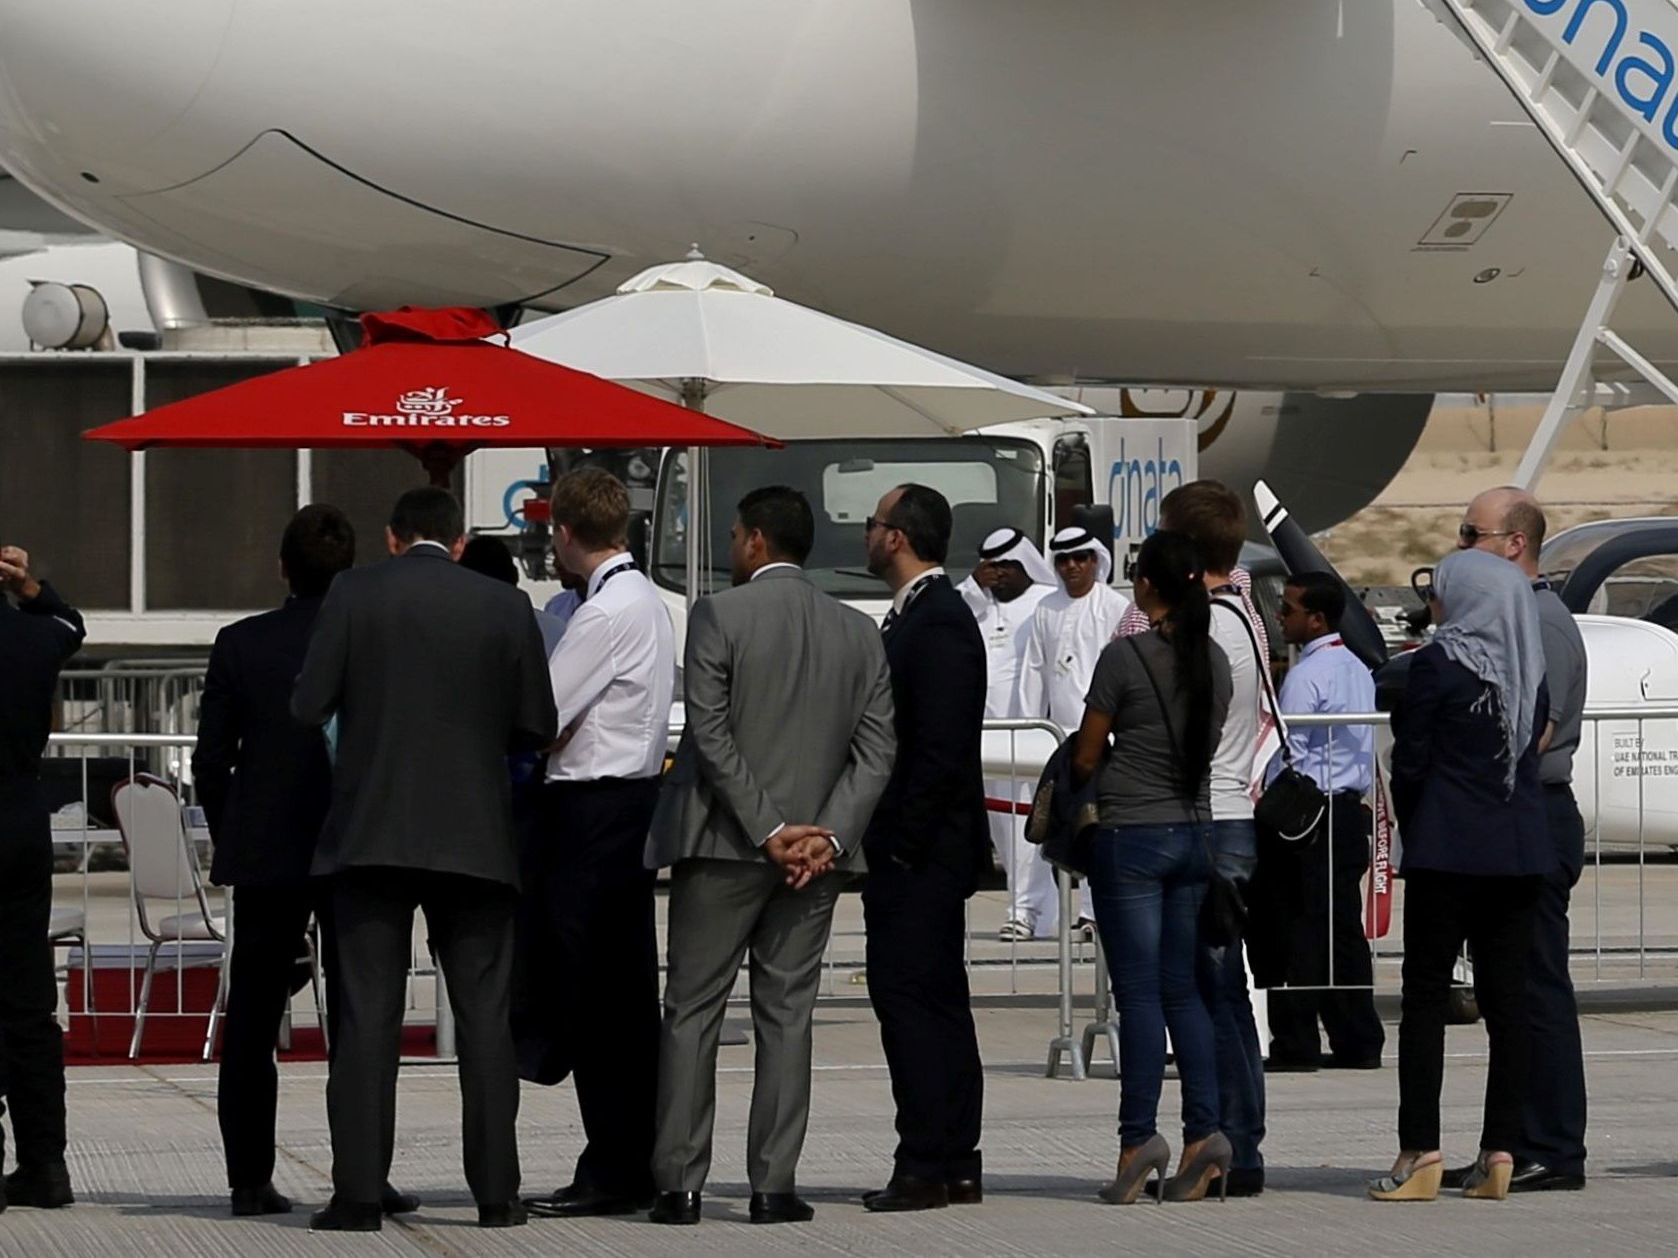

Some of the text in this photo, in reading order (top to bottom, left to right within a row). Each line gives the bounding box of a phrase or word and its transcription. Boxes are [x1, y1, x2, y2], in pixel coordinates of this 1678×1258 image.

[343, 412, 510, 426] Emirates
[1614, 738, 1634, 748] BUILT
[1614, 752, 1630, 762] UAE
[1632, 750, 1667, 761] NATIONAL
[1614, 766, 1625, 777] OF
[1377, 819, 1389, 860] BEFORE
[1374, 860, 1388, 895] FLIGHT
